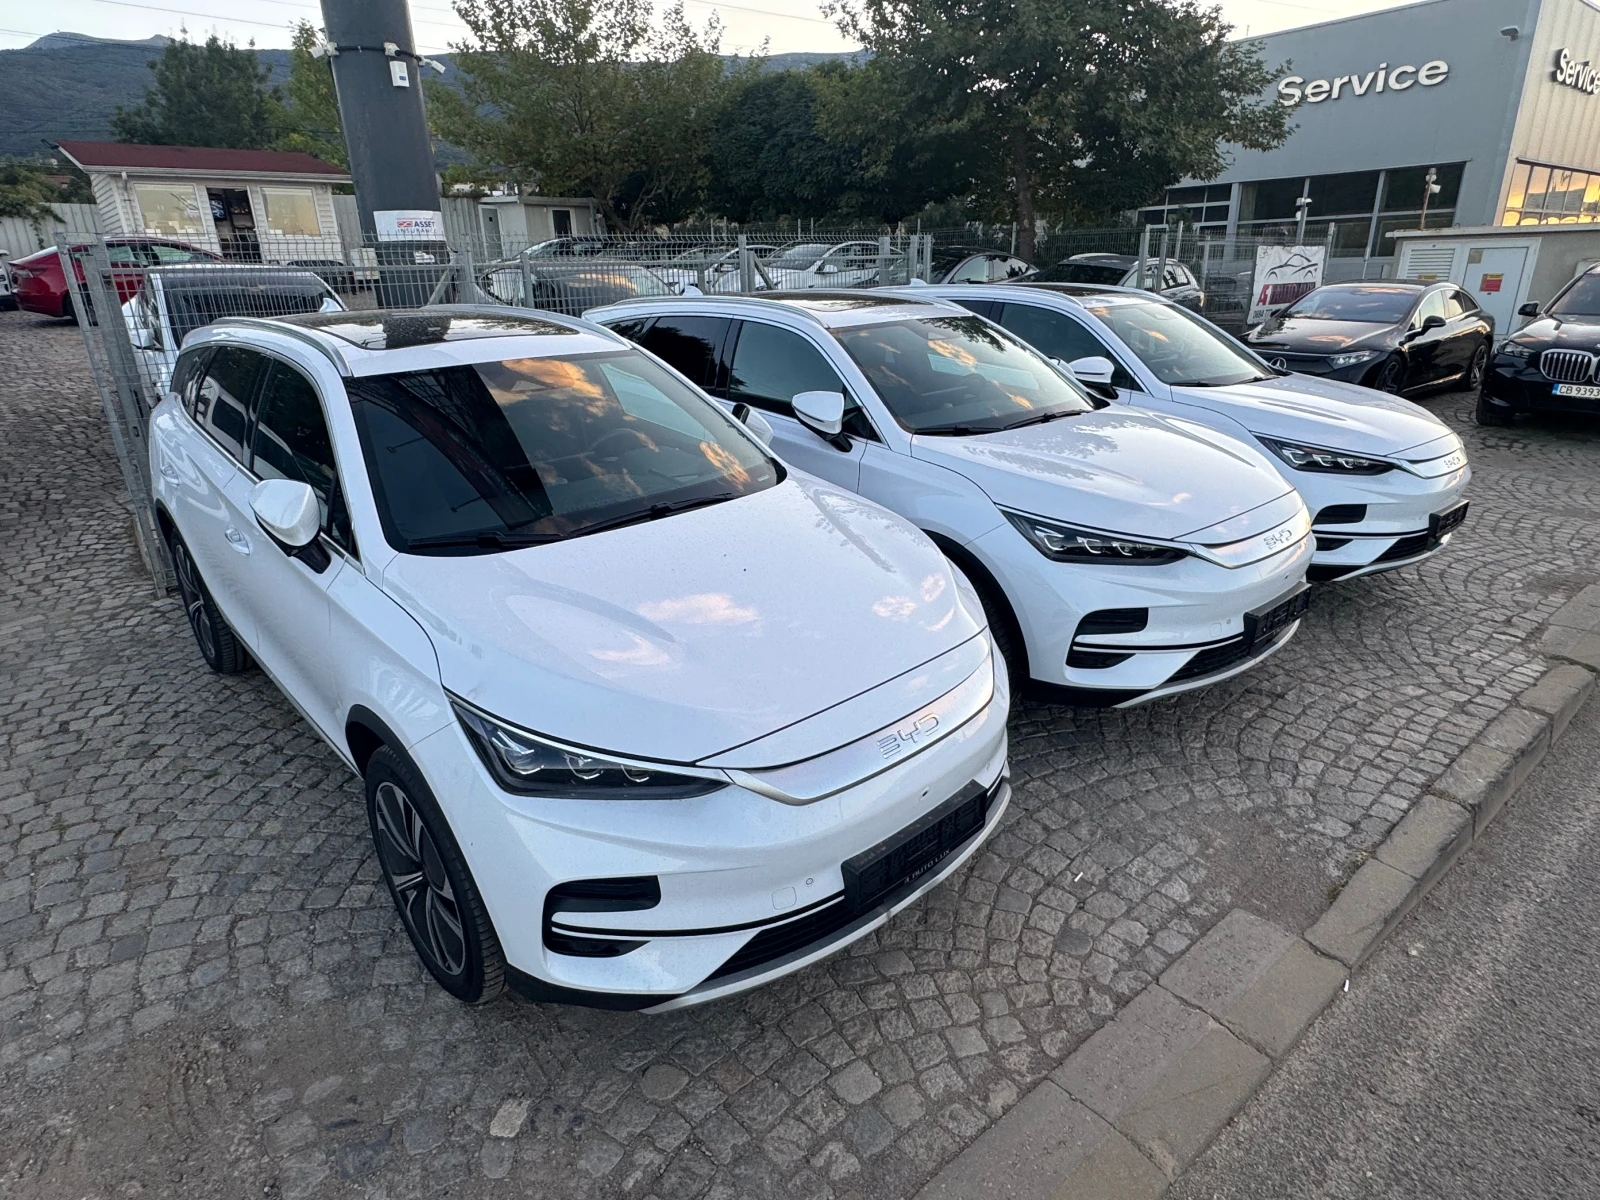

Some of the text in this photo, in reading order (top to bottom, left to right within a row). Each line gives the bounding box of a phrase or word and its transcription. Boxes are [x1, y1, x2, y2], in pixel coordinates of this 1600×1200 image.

[1277, 60, 1449, 106] Service
[1557, 47, 1600, 95] Service
[1559, 385, 1600, 397] CB 9393
[1263, 528, 1293, 550] BYD
[877, 713, 939, 759] BYD
[912, 860, 934, 879] AUTO
[935, 849, 950, 863] LUX
